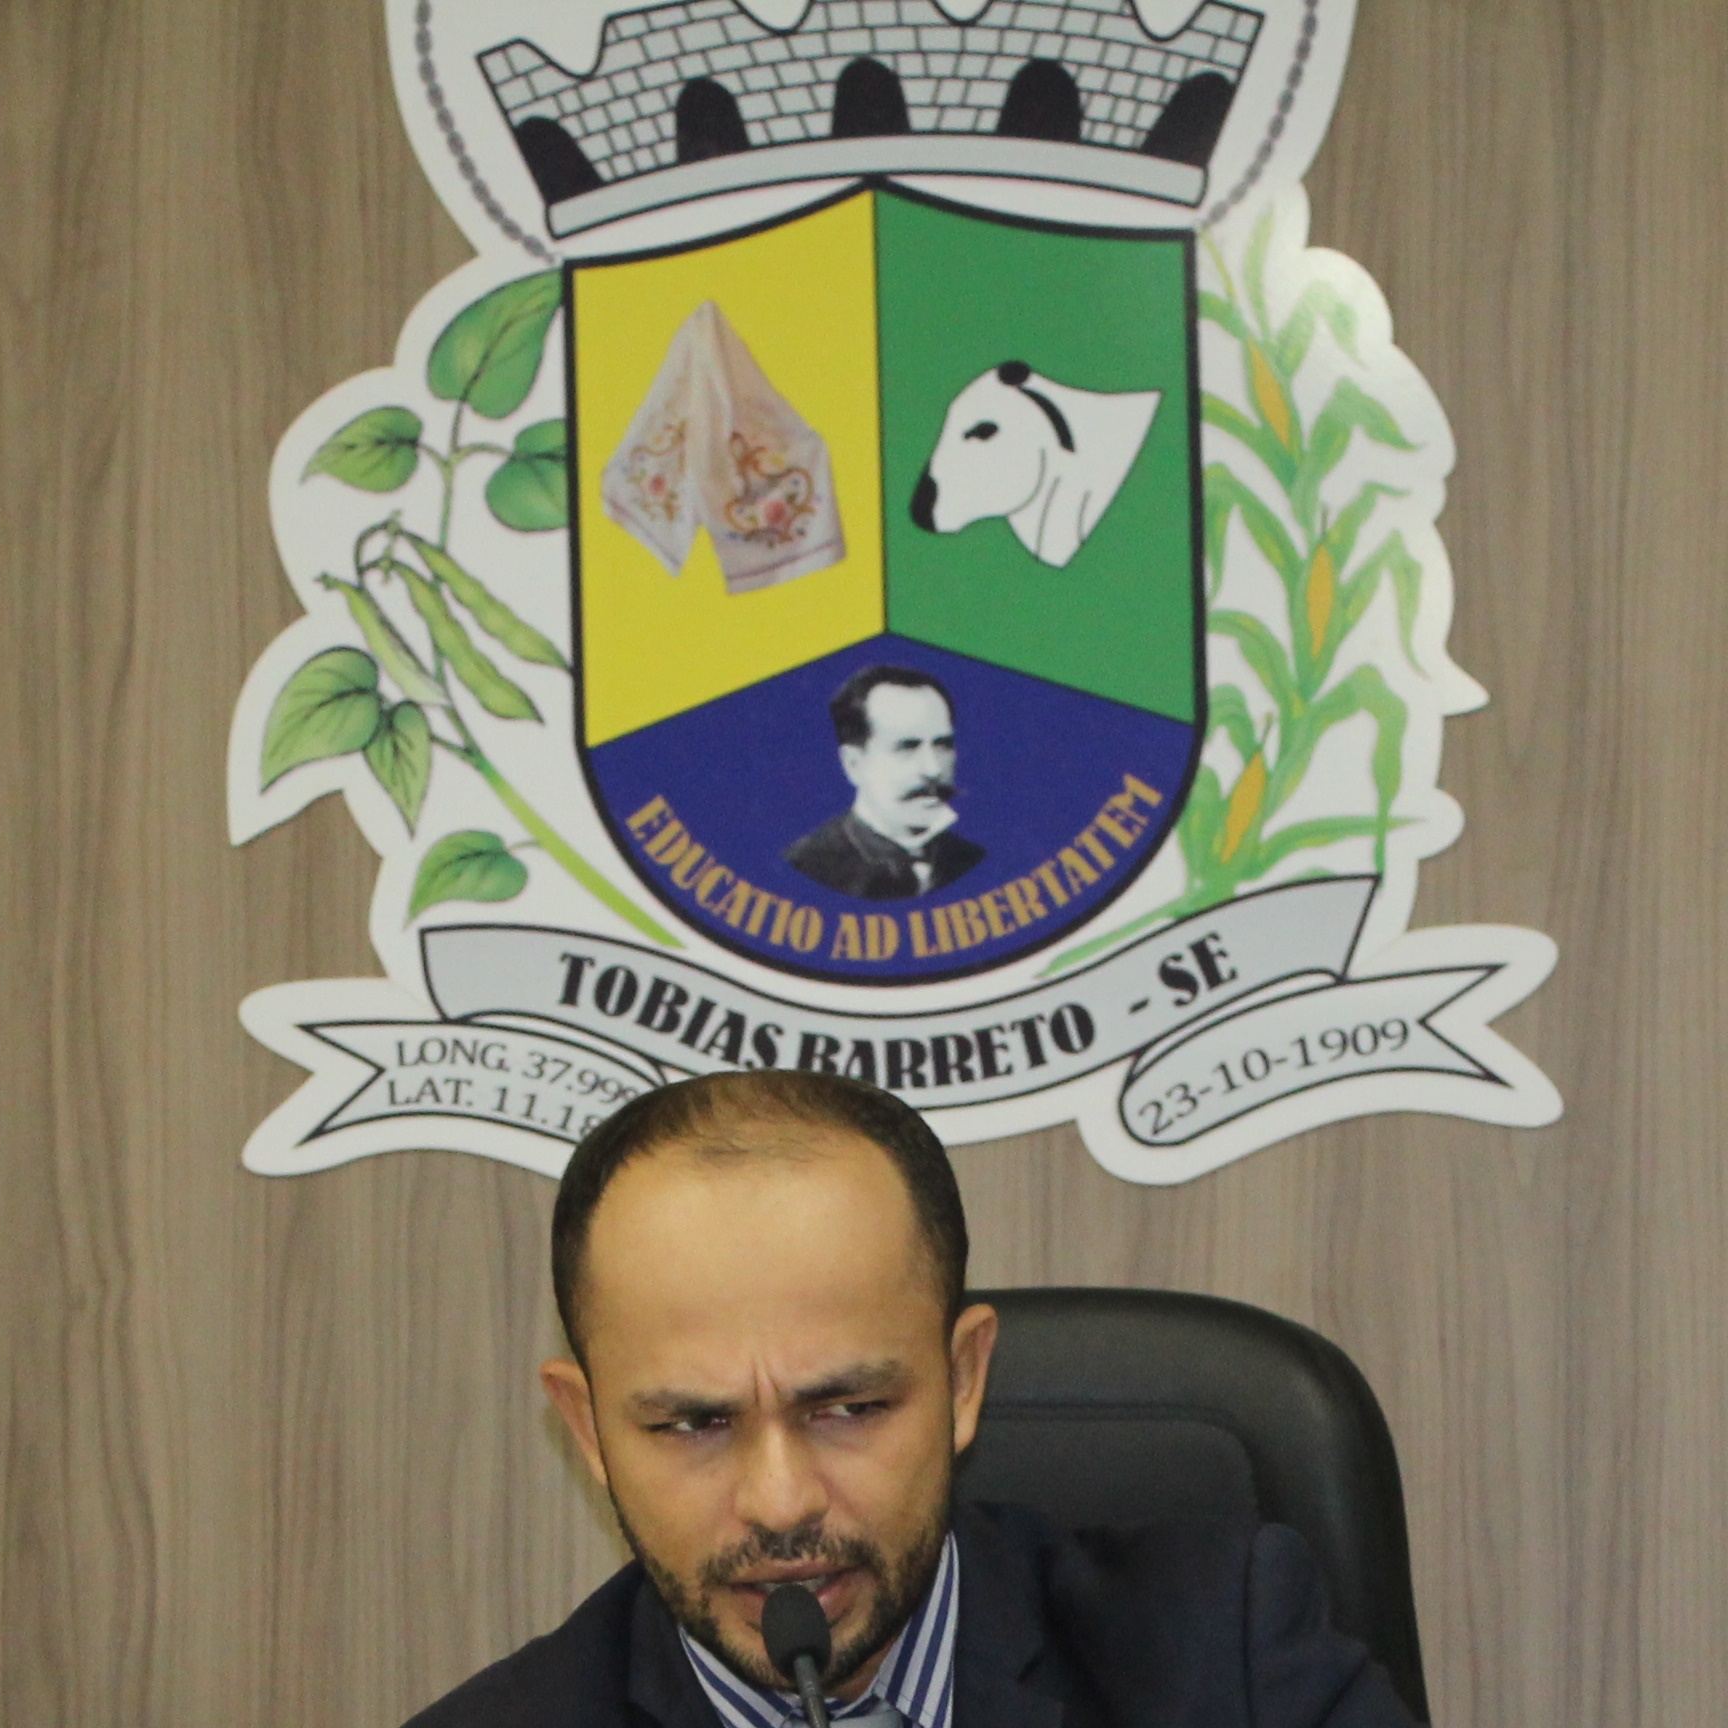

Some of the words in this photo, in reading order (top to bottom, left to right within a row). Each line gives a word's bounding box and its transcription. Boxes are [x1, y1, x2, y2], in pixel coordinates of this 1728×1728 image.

[624, 794, 823, 953] EDUCATIO
[831, 913, 901, 960] AD
[908, 772, 1164, 958] LIBERTATEM
[395, 1036, 510, 1073] LONG.
[559, 952, 785, 1072] TOBIAS
[797, 1001, 1096, 1091] BARRETO
[1128, 996, 1151, 1015] -
[1158, 932, 1238, 1007] SE
[385, 1078, 474, 1107] LAT.
[1138, 1018, 1410, 1136] 23-10-1909
